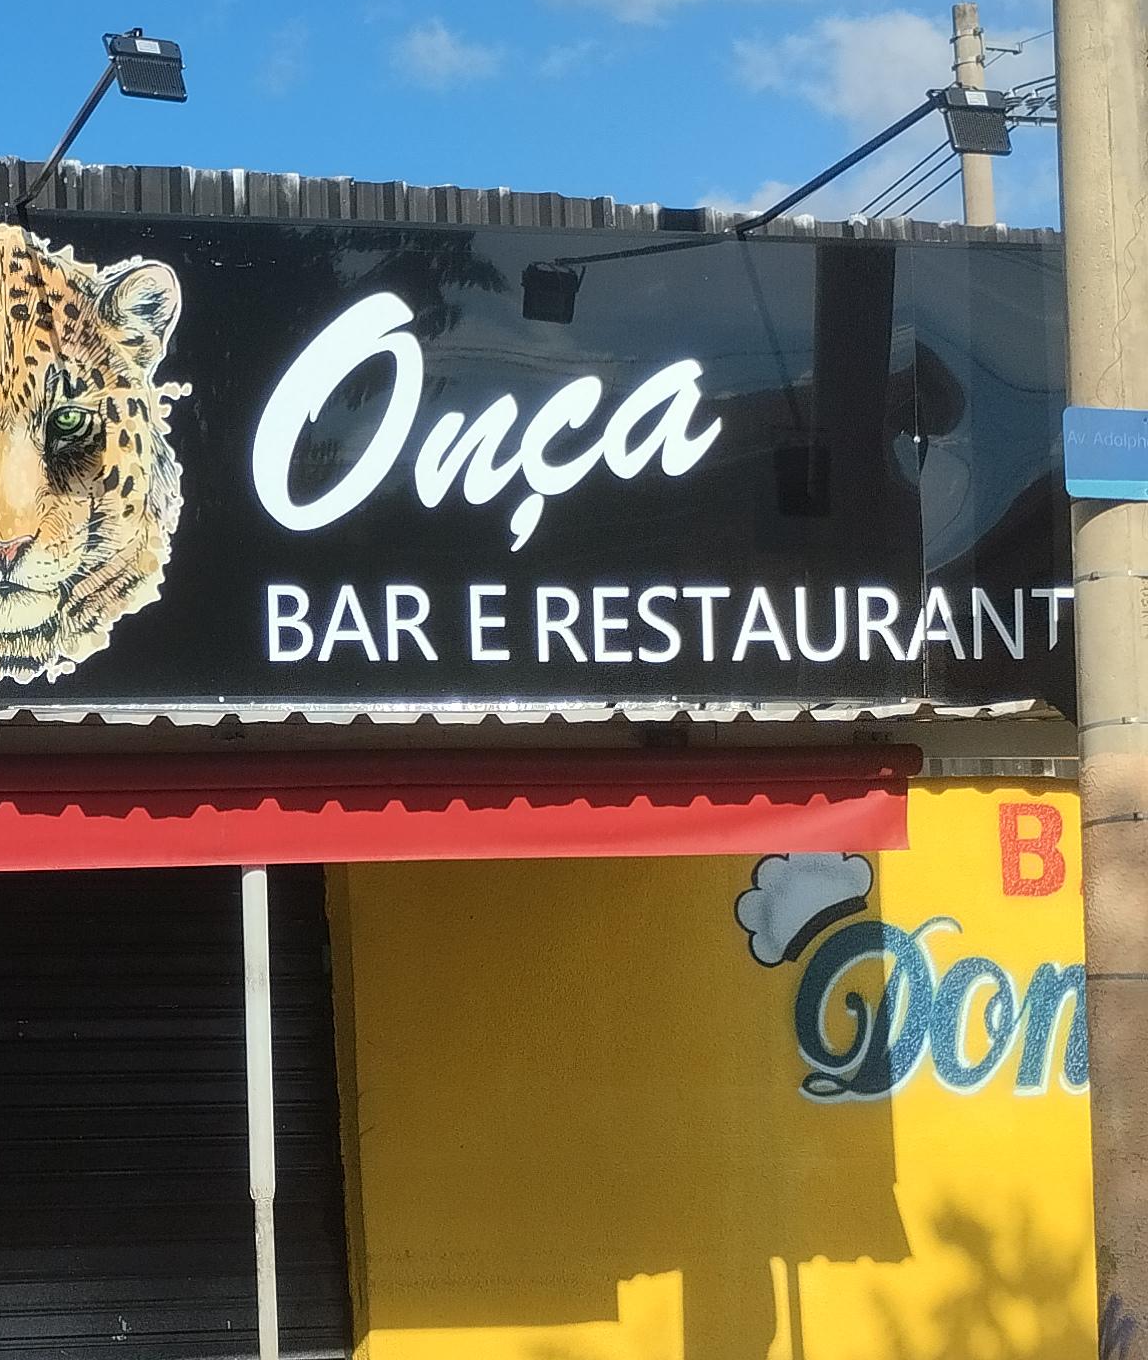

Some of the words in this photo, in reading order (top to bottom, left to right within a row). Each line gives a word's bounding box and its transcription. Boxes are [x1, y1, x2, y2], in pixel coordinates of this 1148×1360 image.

[252, 292, 722, 551] Onça
[1067, 430, 1085, 445] Av
[1093, 431, 1148, 450] Adolph
[267, 584, 439, 663] BAR
[470, 584, 510, 663] E
[538, 586, 1074, 663] RESTAURANT
[999, 802, 1085, 897] B
